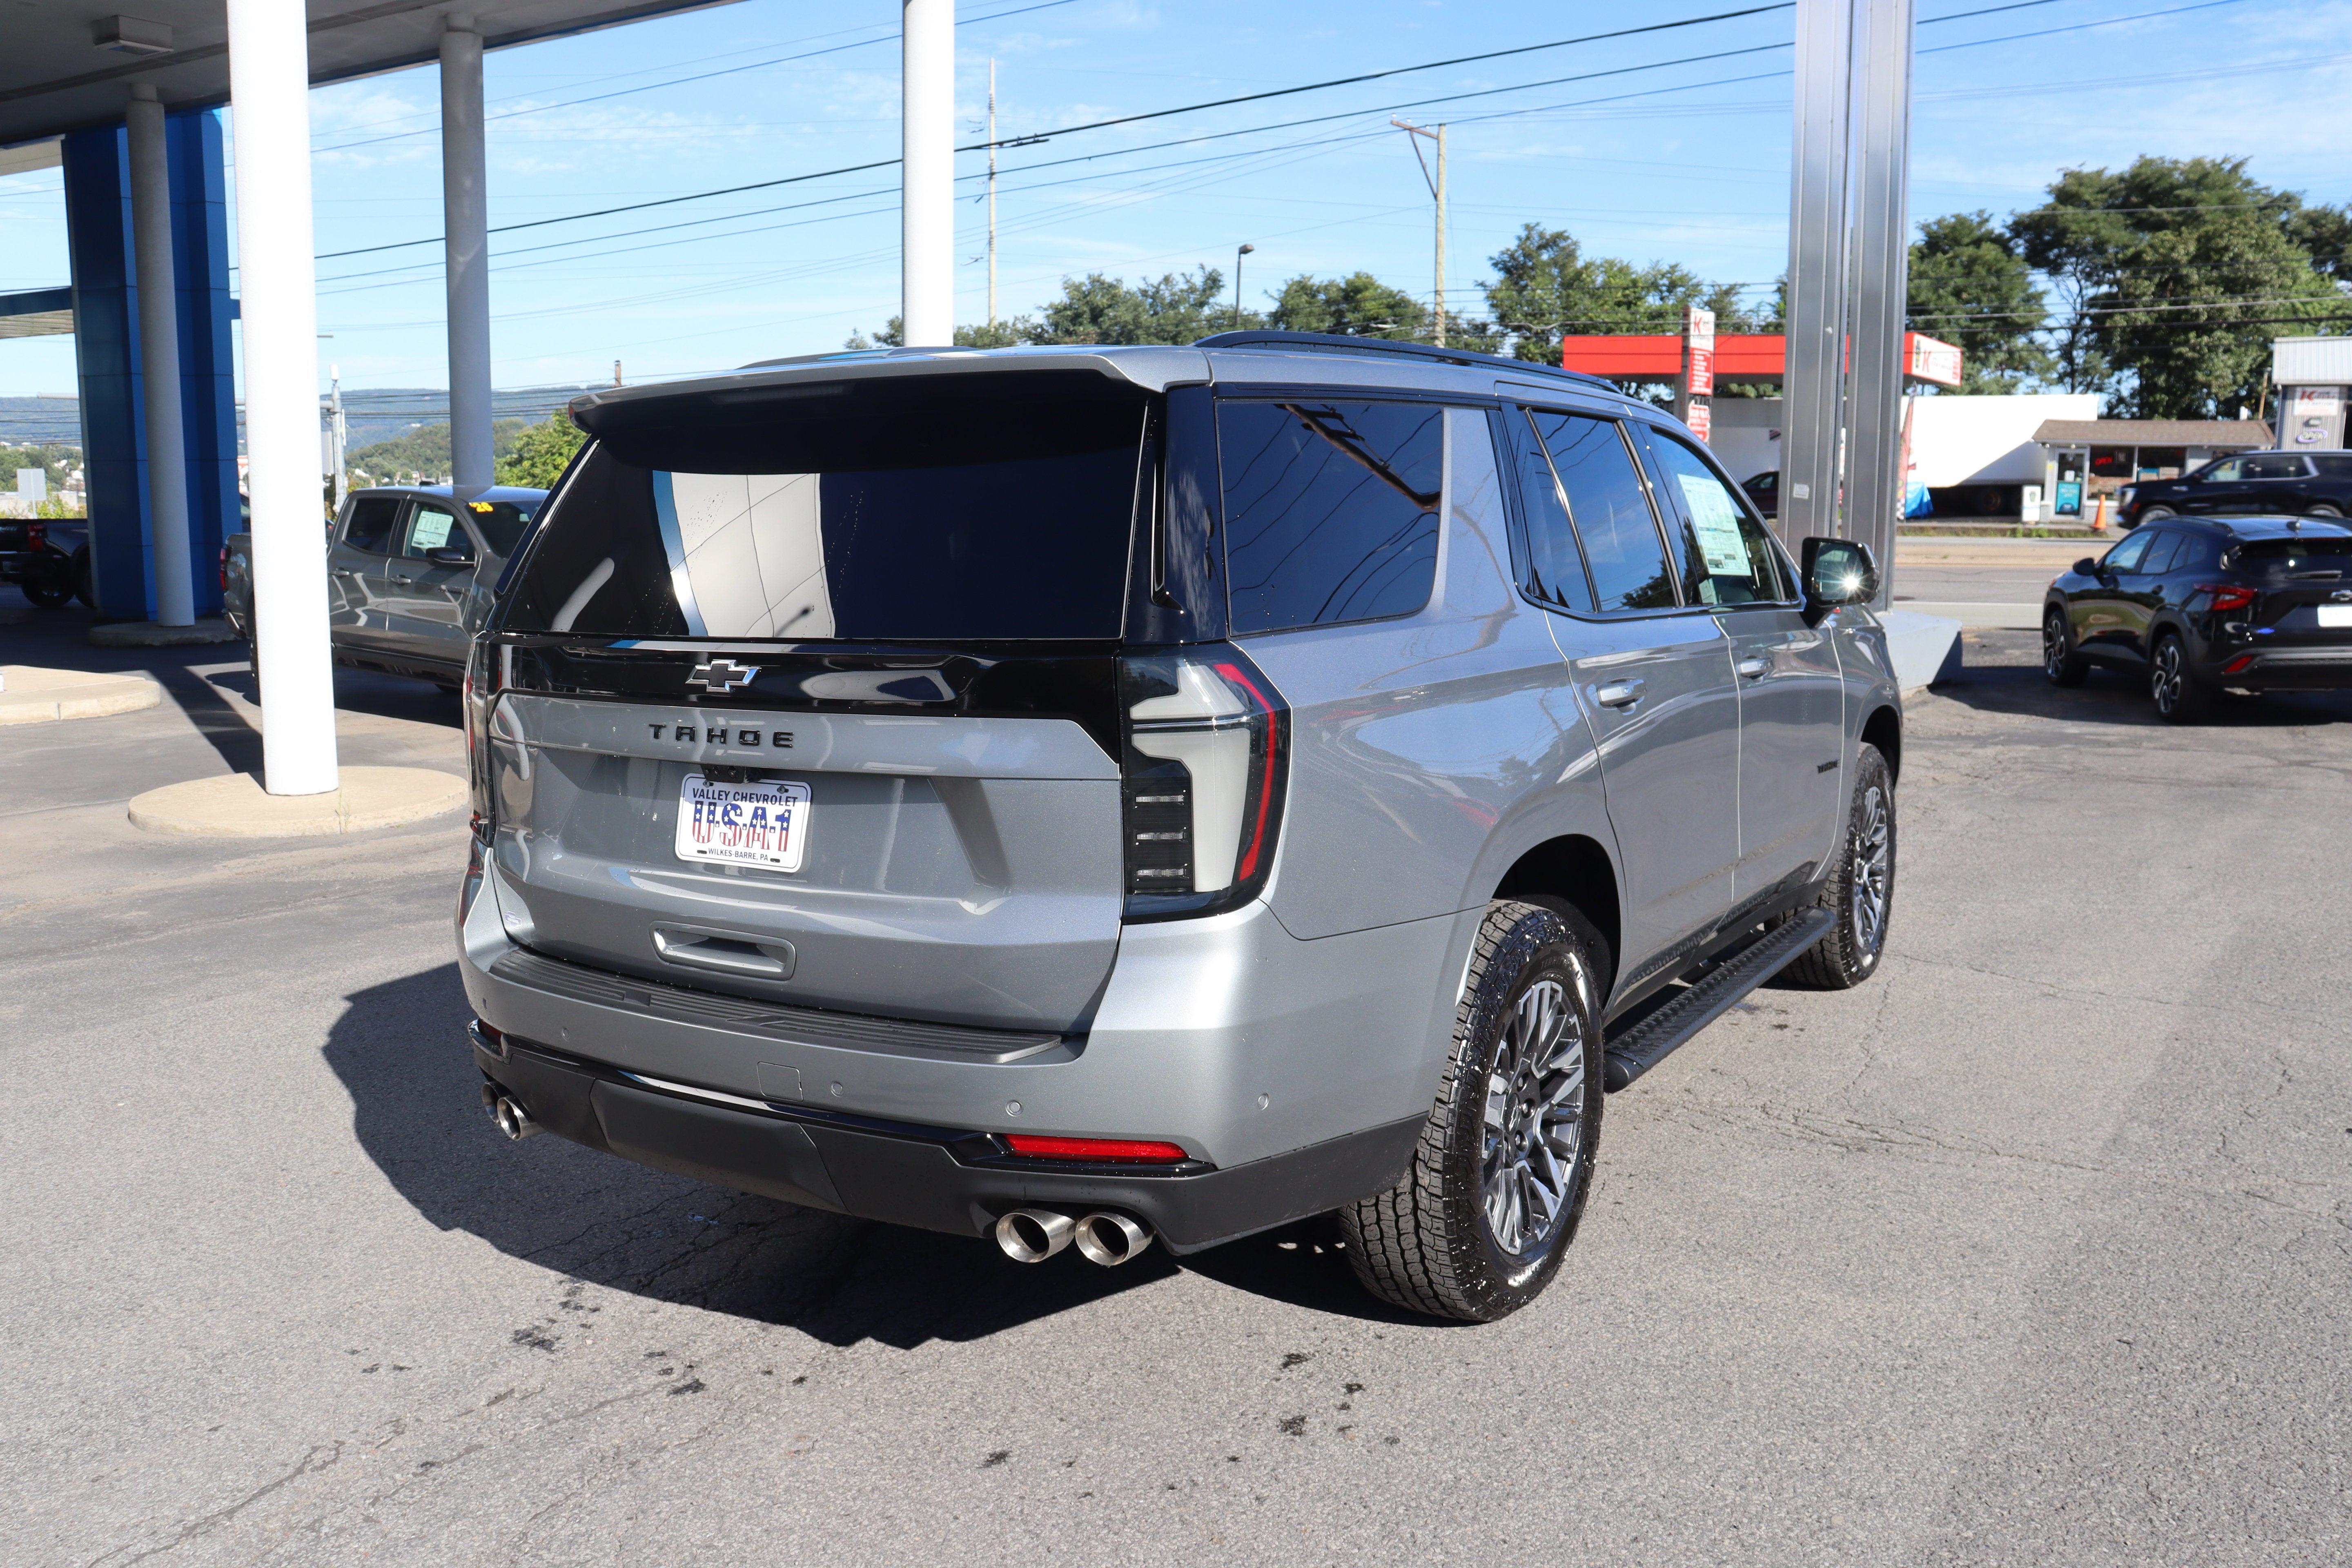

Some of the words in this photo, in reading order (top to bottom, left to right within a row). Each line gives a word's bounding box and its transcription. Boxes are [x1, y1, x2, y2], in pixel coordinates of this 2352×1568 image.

[649, 724, 794, 748] TAHOE
[693, 788, 731, 801] VALLEY
[733, 791, 798, 807] CHEVROLET
[708, 848, 758, 860] WILKES-BARRE,
